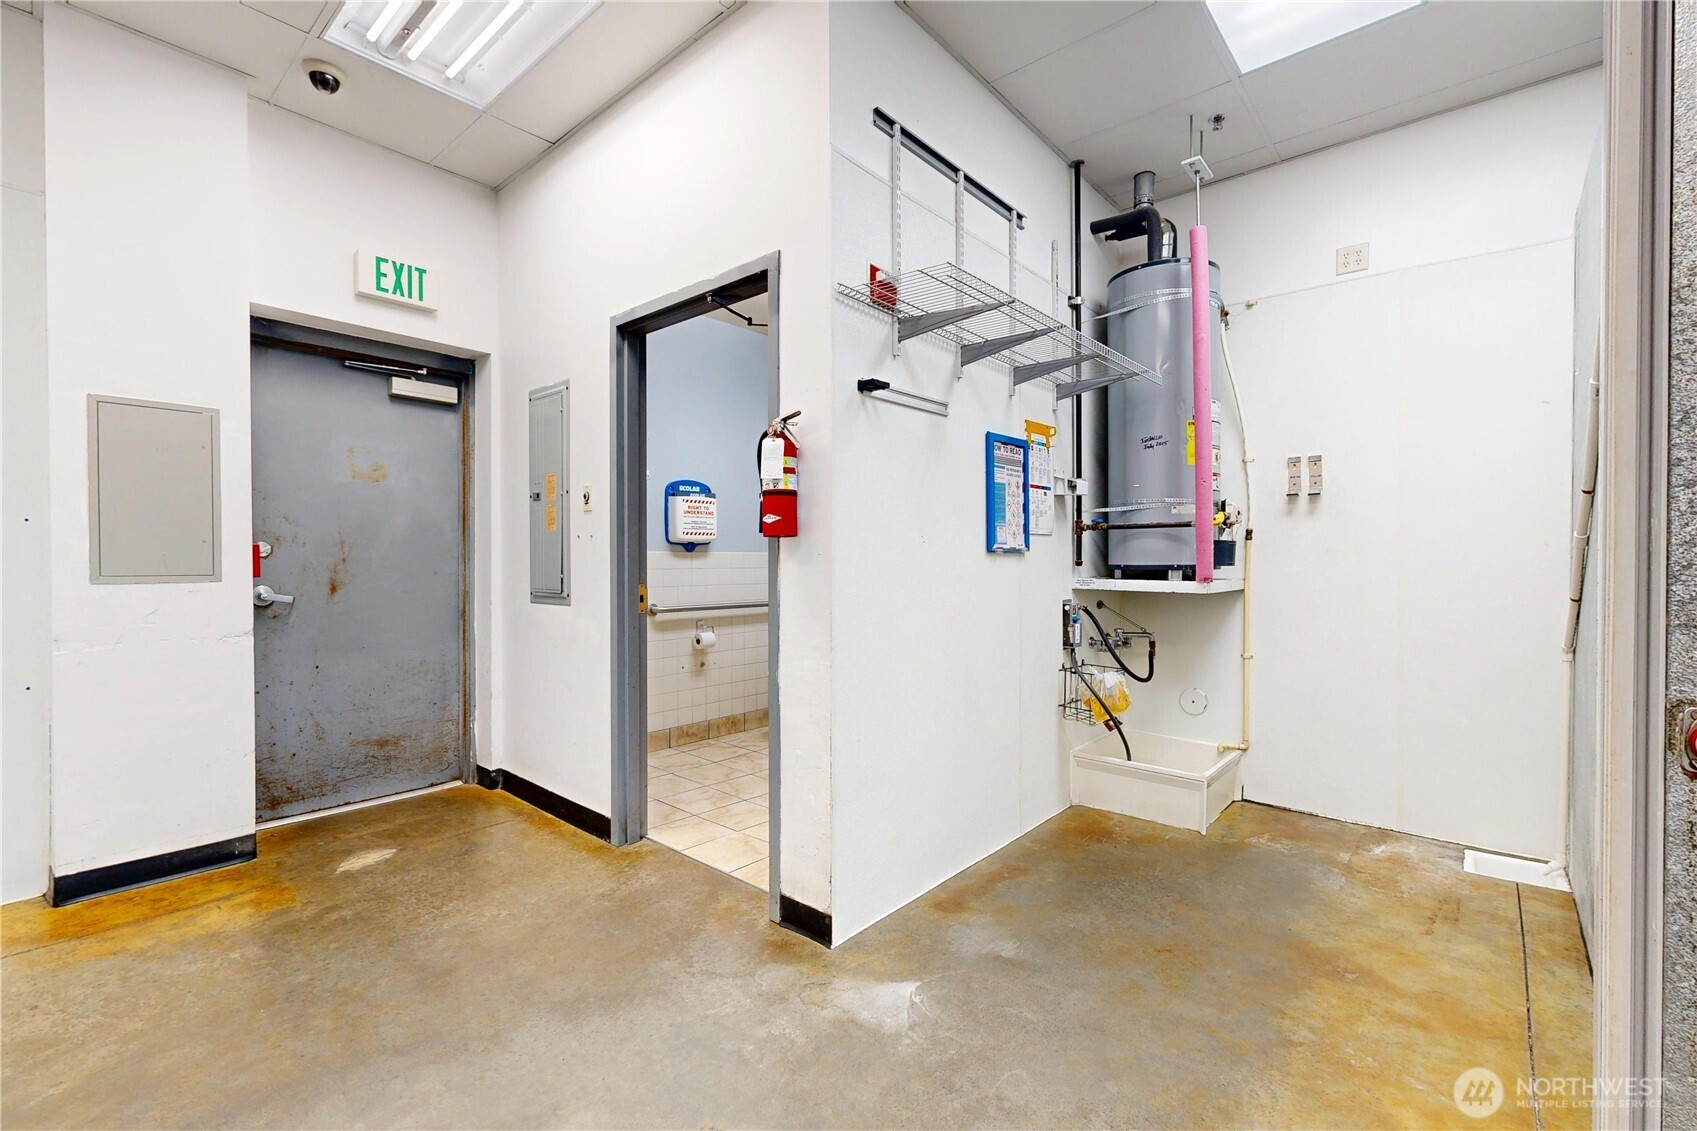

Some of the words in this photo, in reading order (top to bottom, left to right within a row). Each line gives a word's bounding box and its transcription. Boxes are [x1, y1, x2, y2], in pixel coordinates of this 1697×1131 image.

[375, 256, 427, 302] EXIT
[1003, 445, 1009, 453] TO
[1010, 447, 1022, 456] READ
